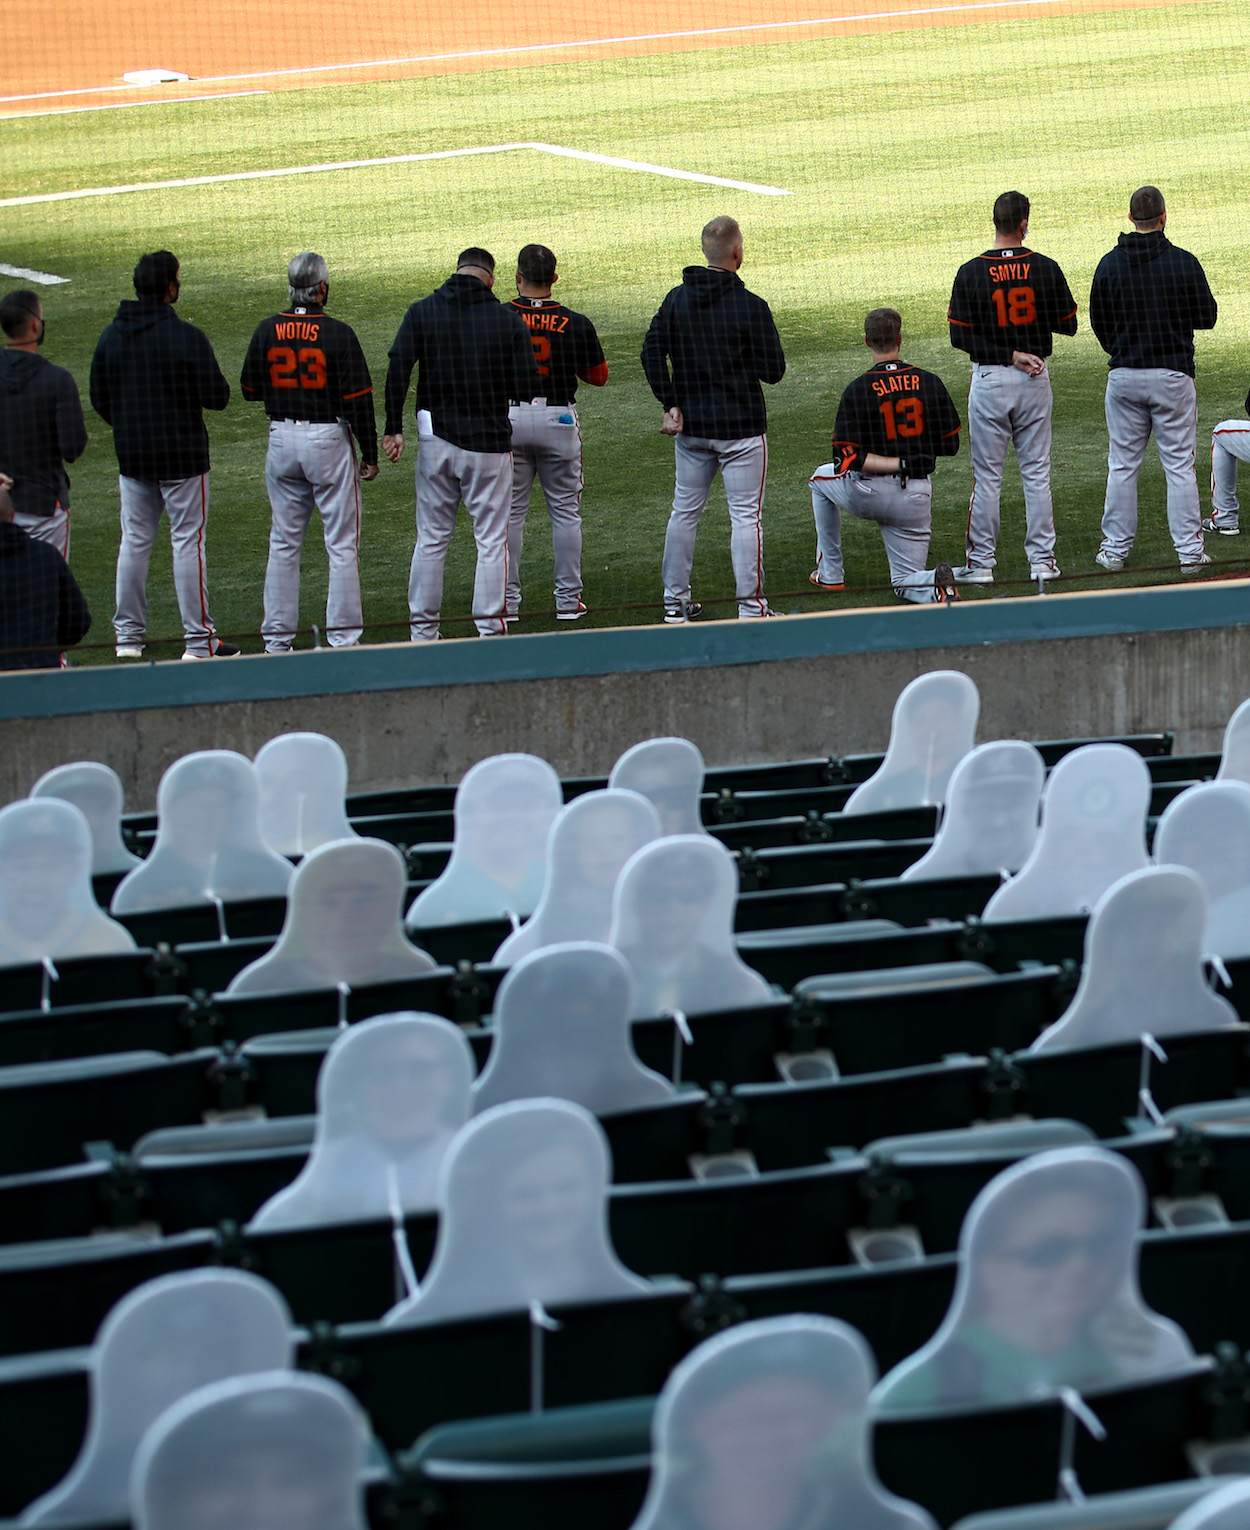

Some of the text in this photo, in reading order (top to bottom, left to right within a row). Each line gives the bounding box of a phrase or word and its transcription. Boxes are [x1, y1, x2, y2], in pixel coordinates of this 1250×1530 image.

[989, 263, 1030, 282] SMYLY
[992, 287, 1036, 326] 18
[275, 322, 321, 343] WOTUS
[268, 348, 327, 387] 23
[872, 375, 919, 396] SLATER
[880, 397, 925, 440] 13
